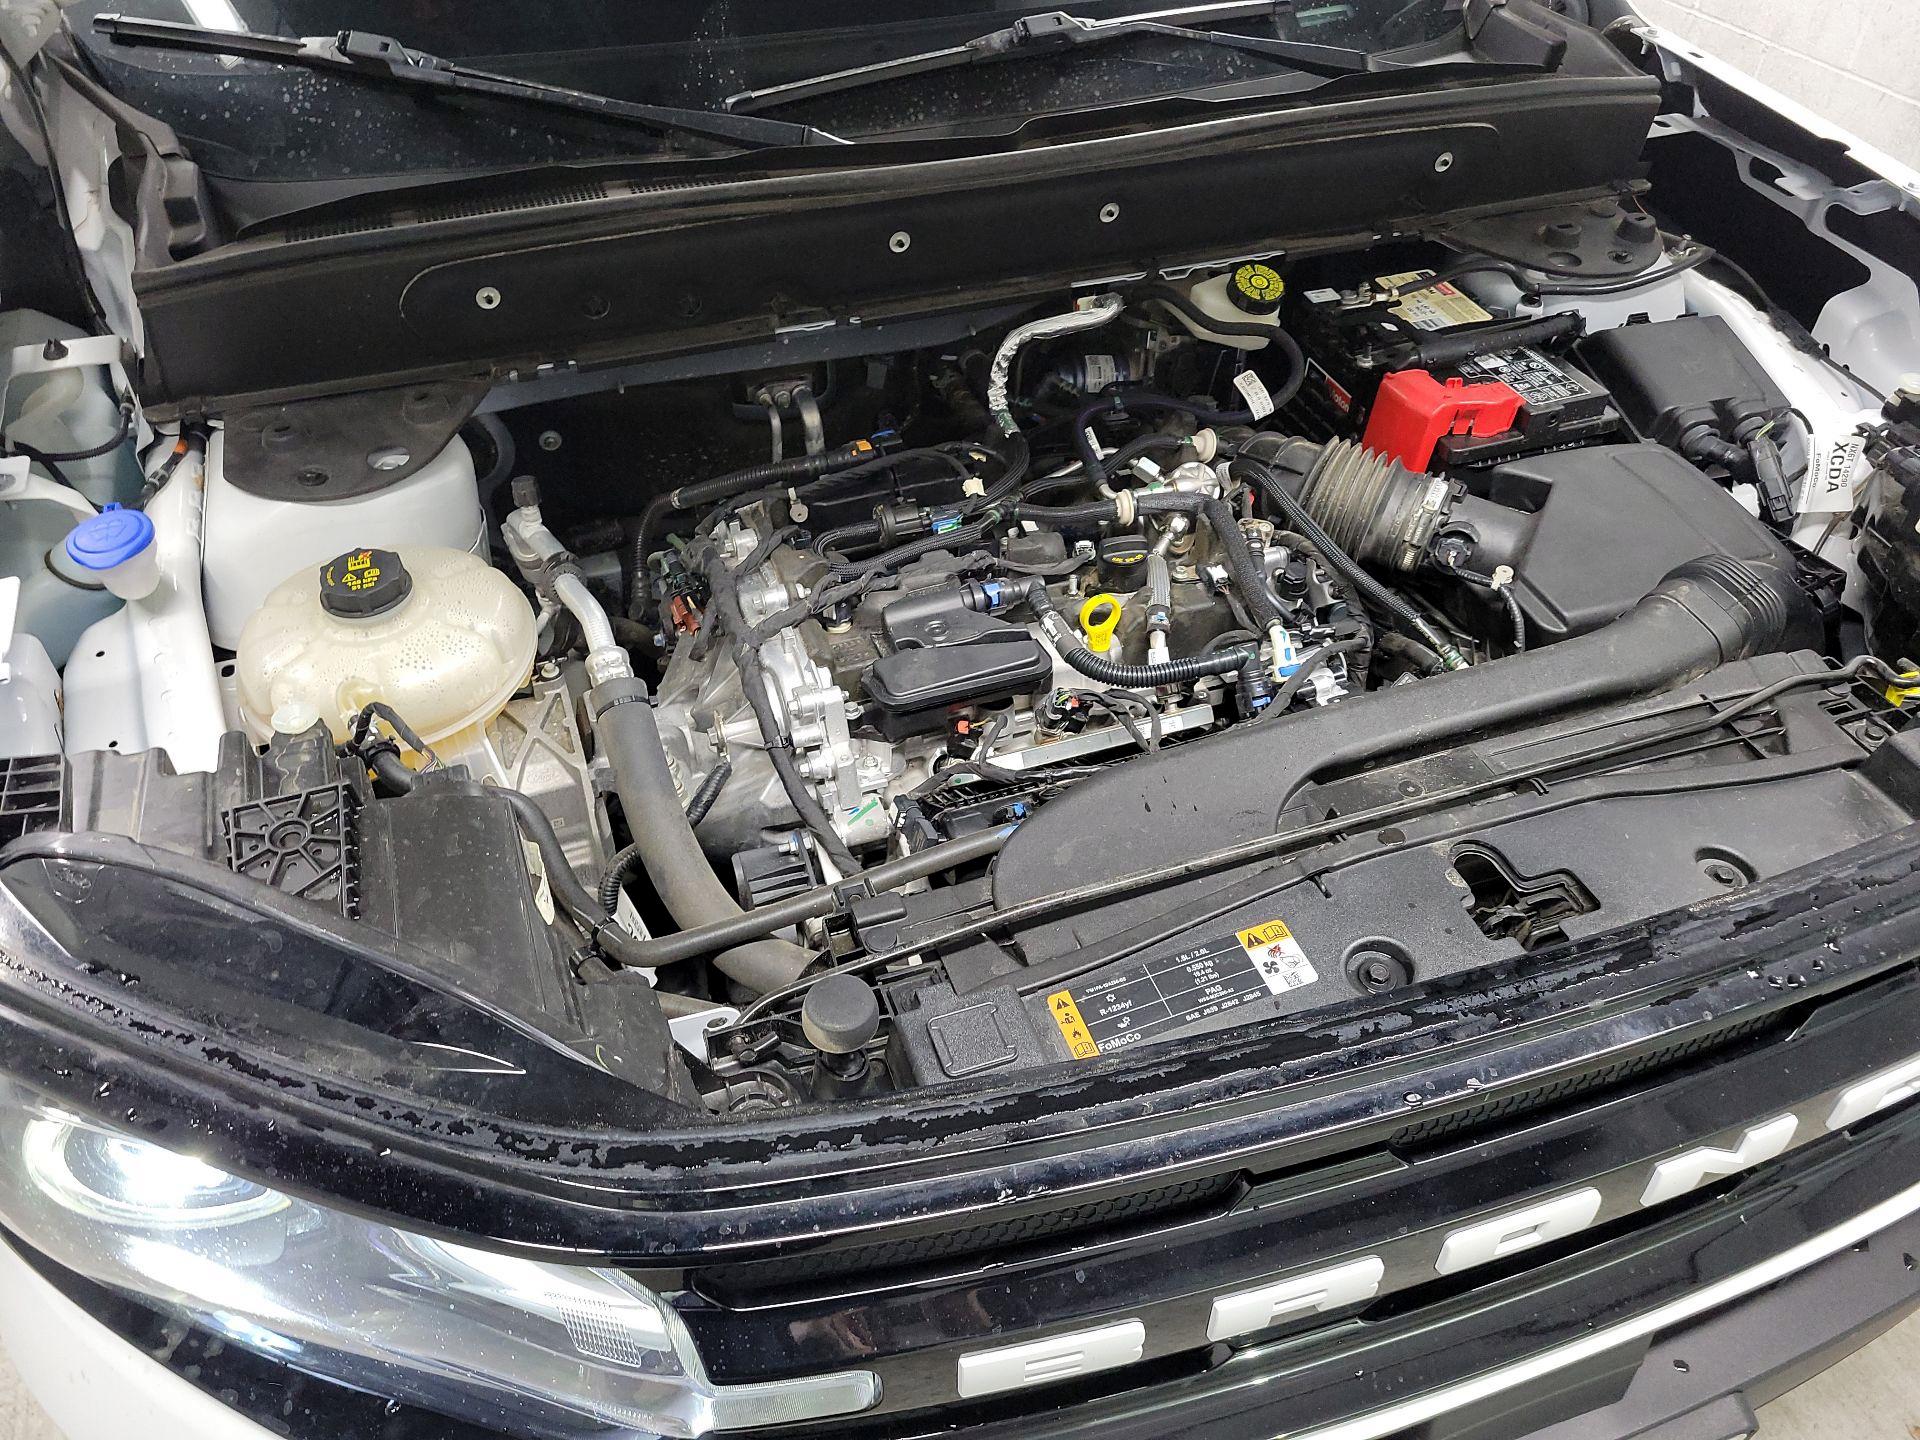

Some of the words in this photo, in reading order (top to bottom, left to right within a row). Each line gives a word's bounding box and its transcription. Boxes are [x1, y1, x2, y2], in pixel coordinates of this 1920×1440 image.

[1812, 453, 1822, 488] FoMoCo
[1826, 441, 1850, 494] XCDA
[1205, 984, 1223, 995] PAG
[1099, 1000, 1133, 1016] R-1234yf
[1185, 1012, 1201, 1021] SAE
[1098, 1033, 1142, 1052] FoMoCo
